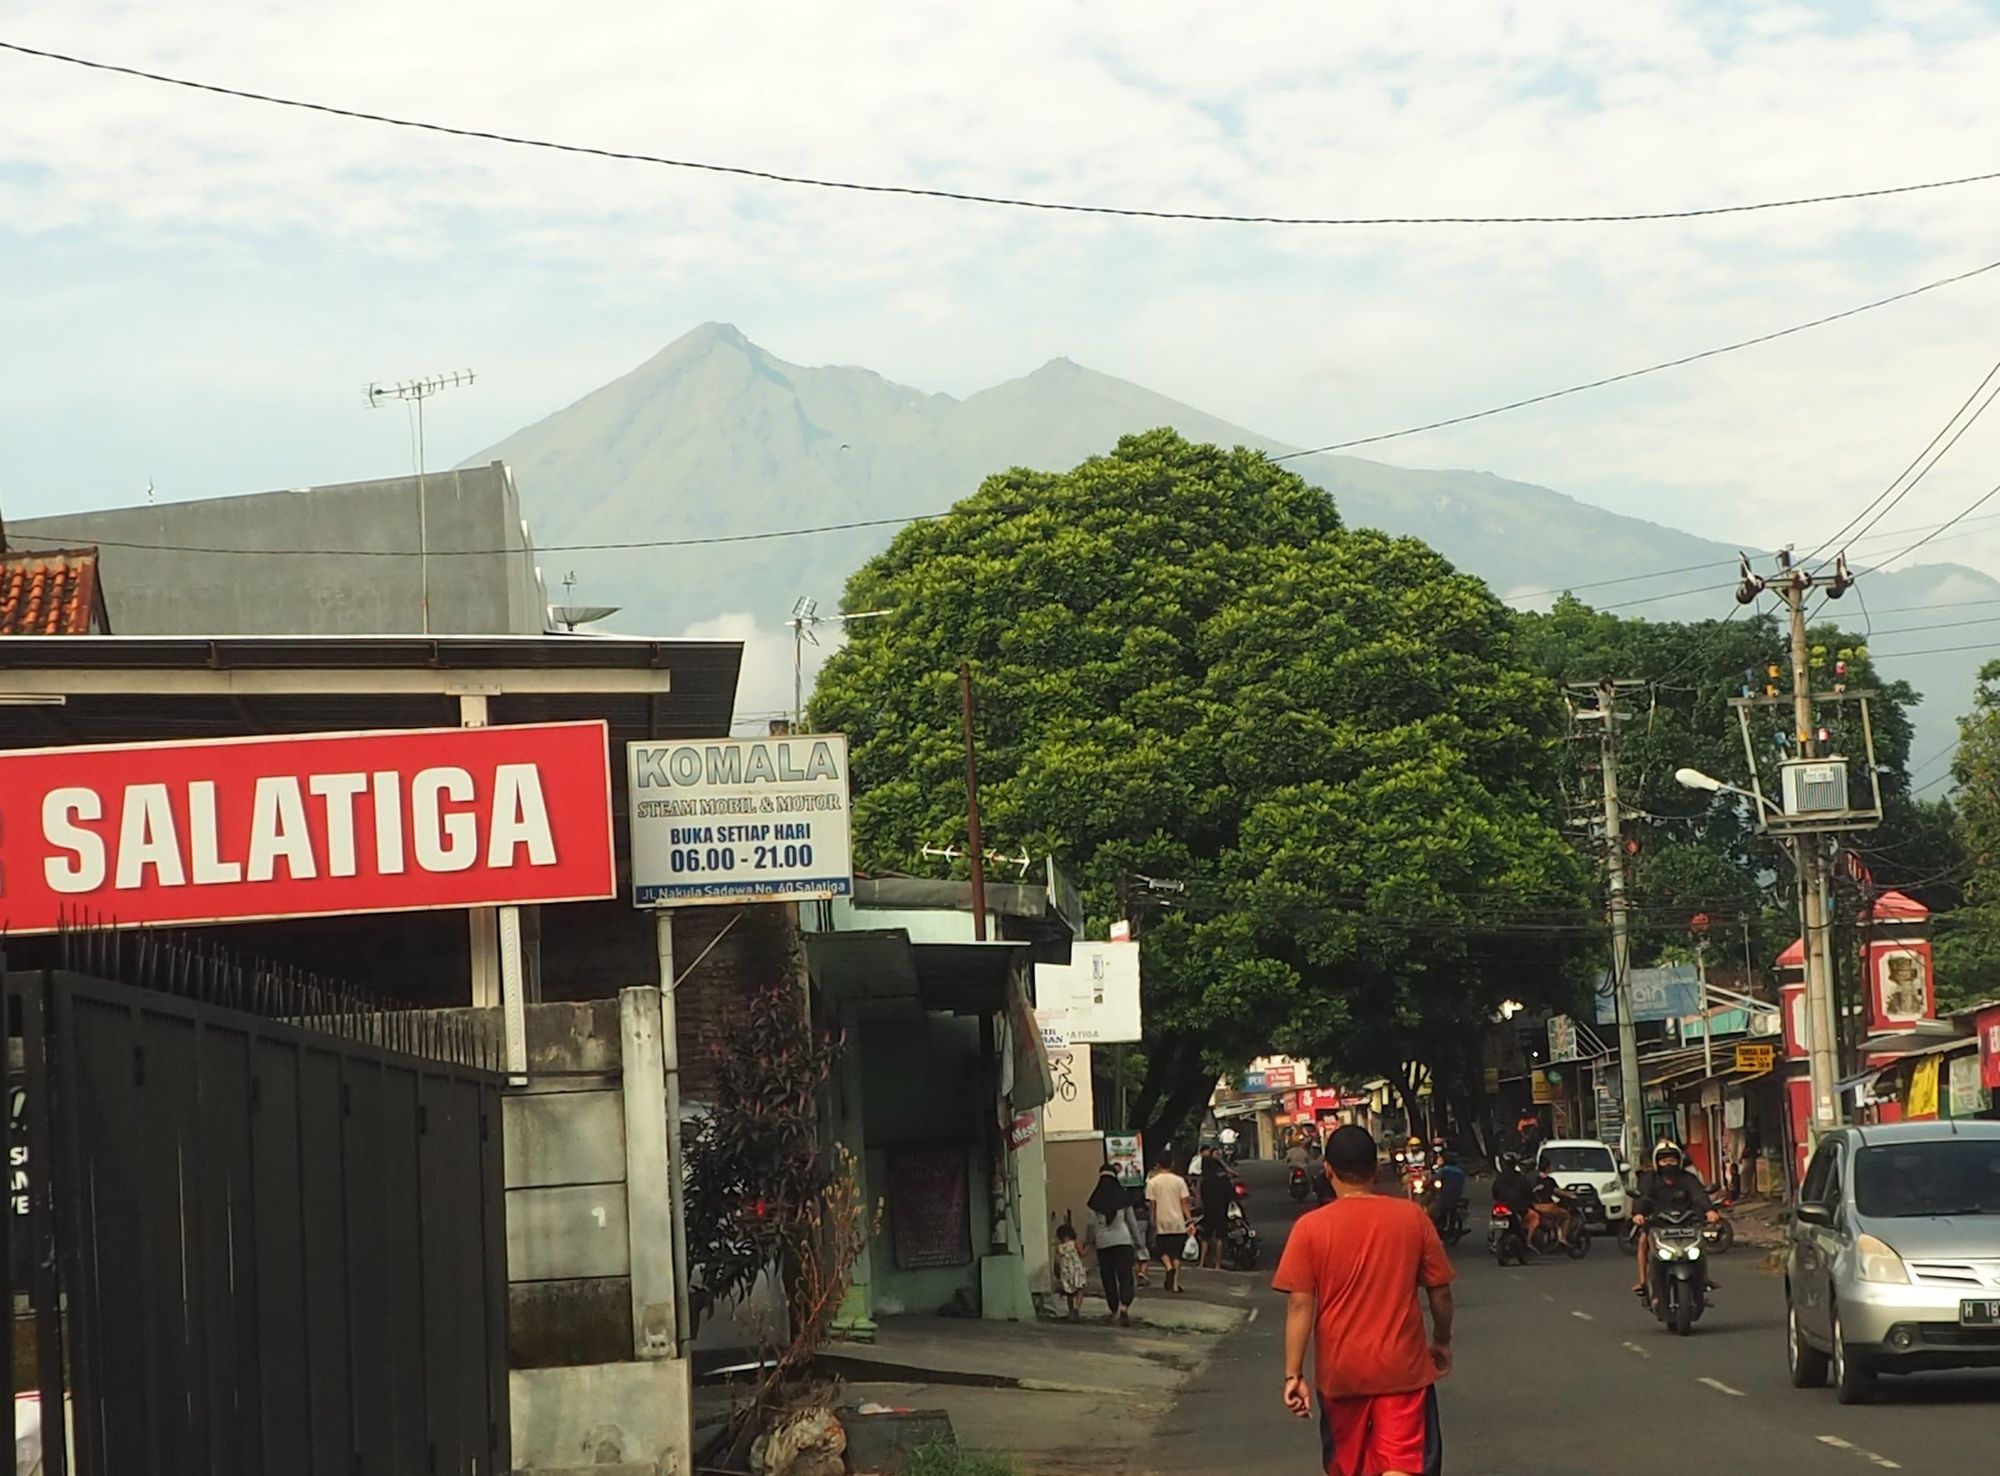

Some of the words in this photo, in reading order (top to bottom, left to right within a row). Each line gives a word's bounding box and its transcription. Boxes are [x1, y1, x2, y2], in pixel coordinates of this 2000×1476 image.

[636, 741, 839, 788] KOMALA
[637, 799, 697, 818] STEAM
[699, 796, 757, 816] MOBIL
[759, 796, 775, 813] &
[776, 793, 842, 812] MOTOR
[41, 763, 557, 893] SALATIGA
[670, 826, 712, 845] BUKA
[717, 824, 770, 843] SETIAP
[774, 823, 811, 841] HARI
[670, 848, 735, 873] 06.00
[753, 844, 813, 869] 21.00
[795, 880, 846, 895] Salatiga
[1964, 1302, 1974, 1318] H
